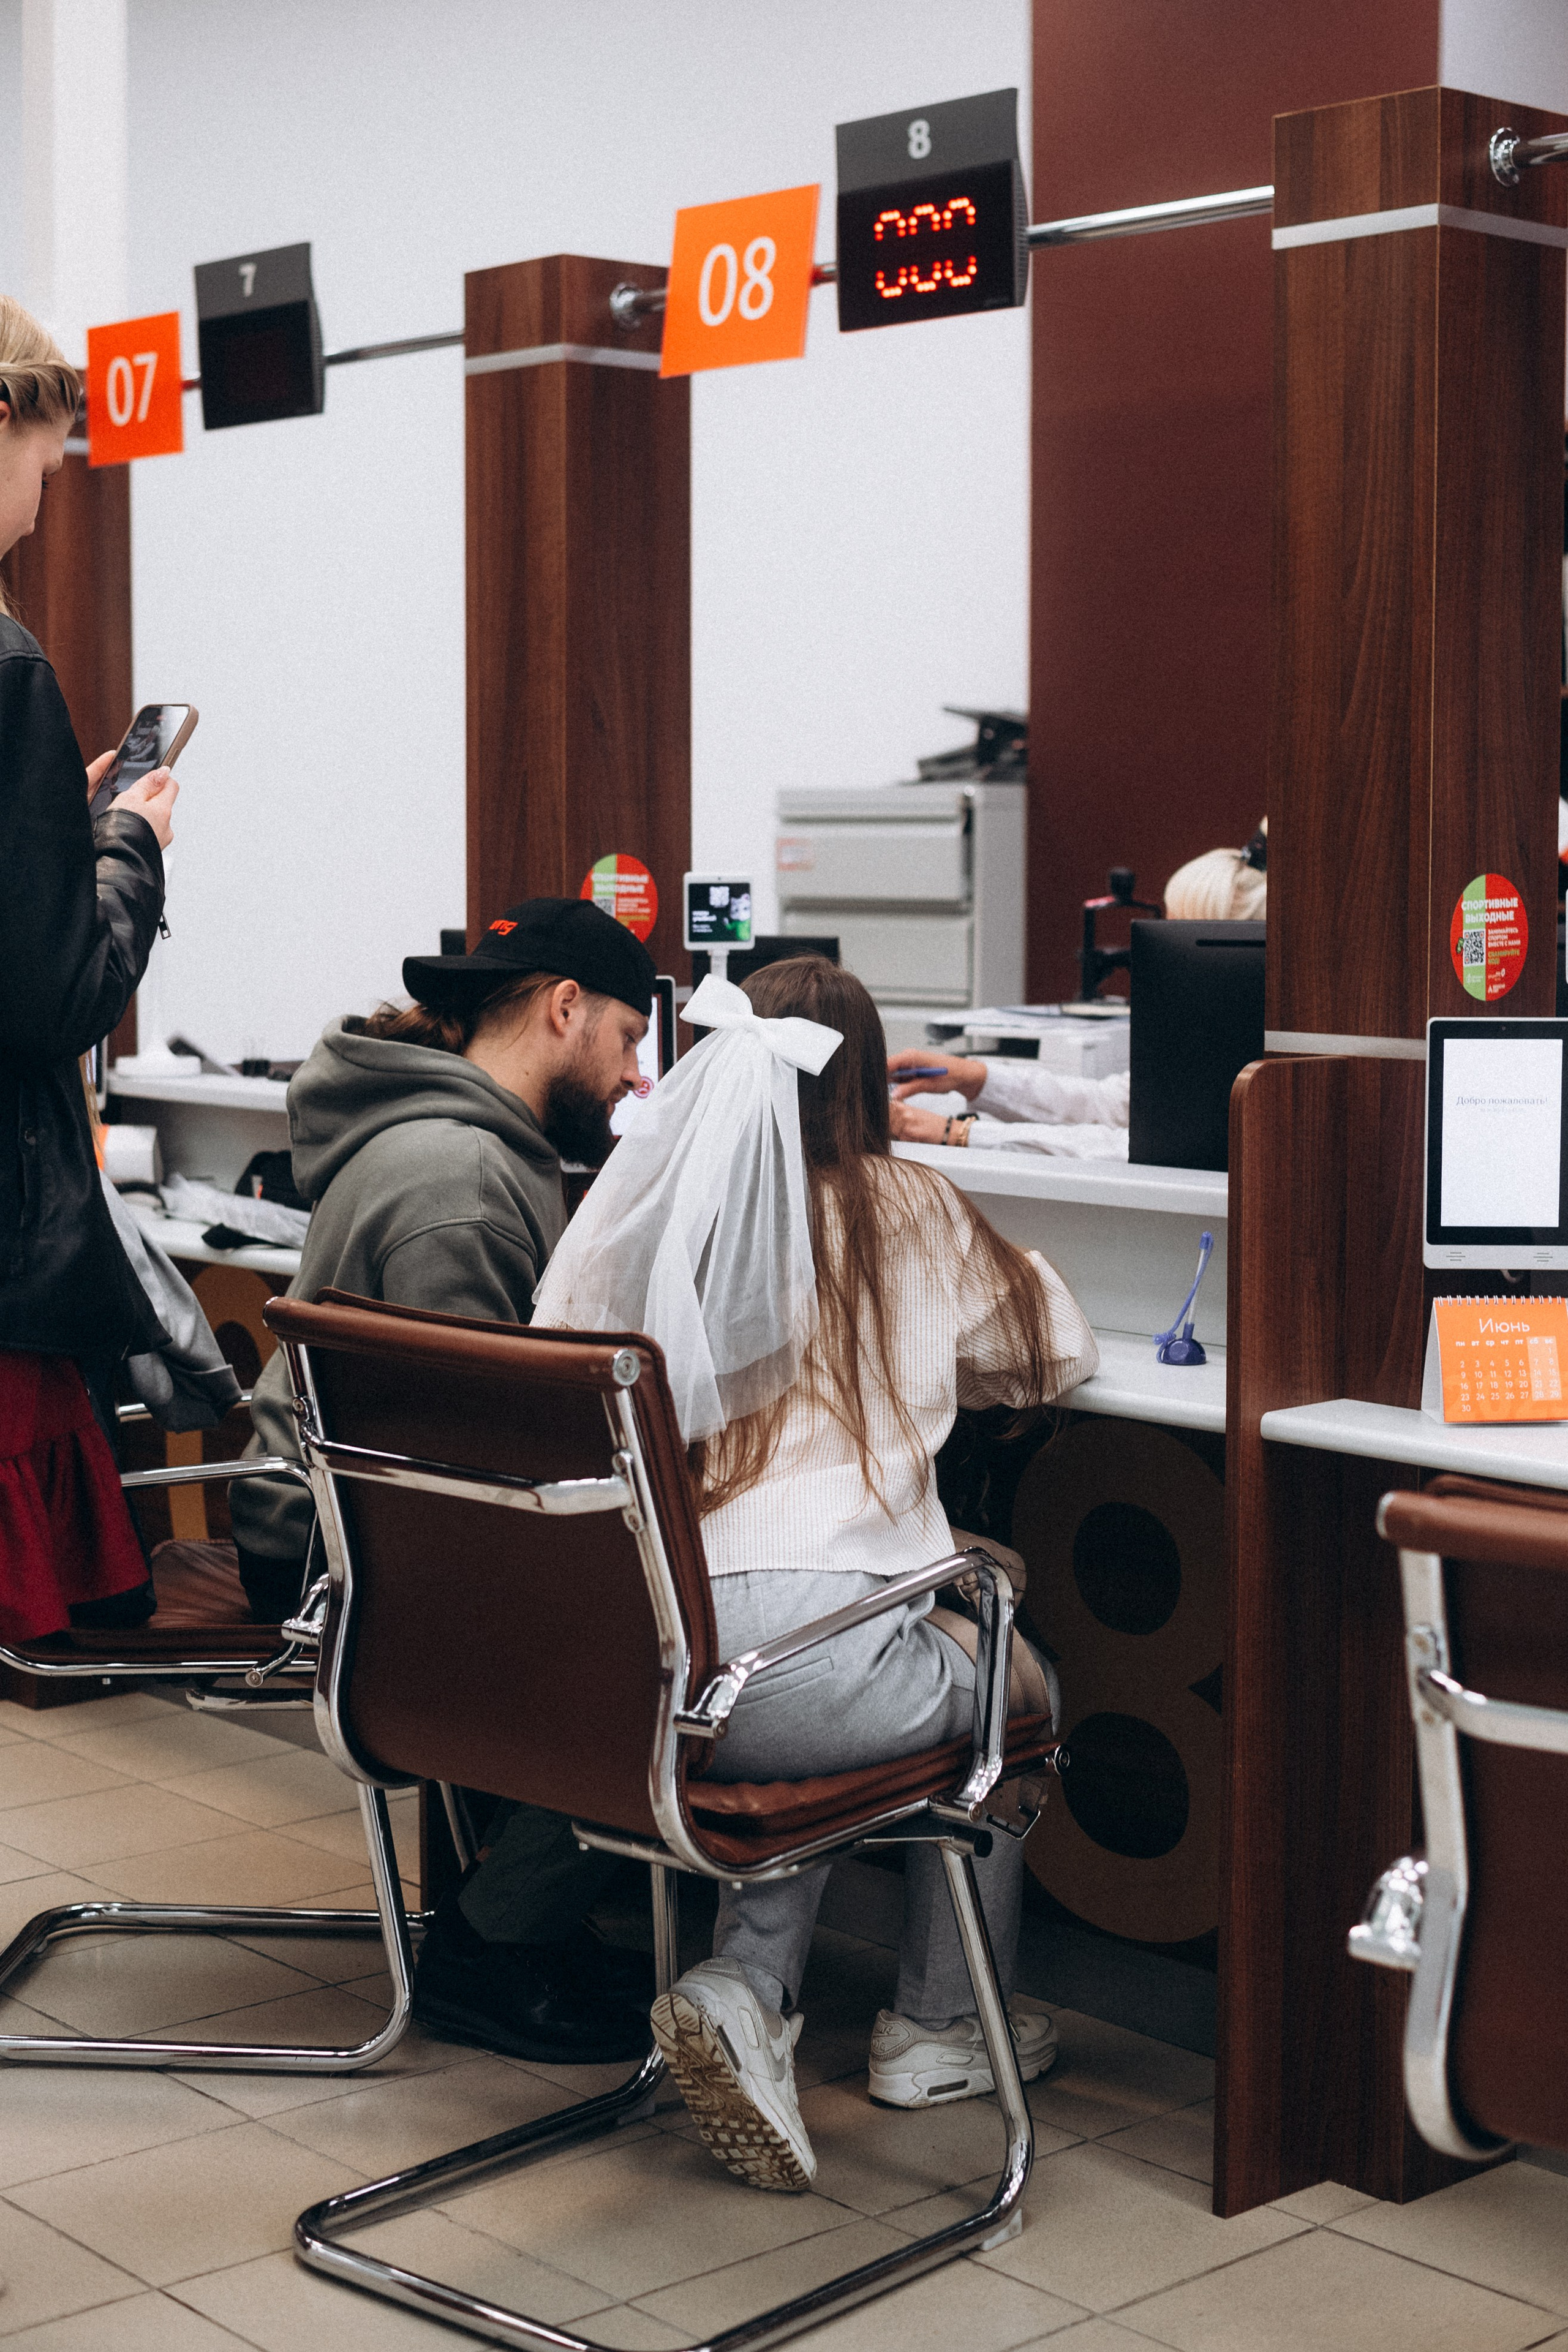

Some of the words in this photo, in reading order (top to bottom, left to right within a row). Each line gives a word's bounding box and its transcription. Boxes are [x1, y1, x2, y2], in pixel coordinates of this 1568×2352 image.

[907, 119, 932, 159] 8
[238, 262, 257, 297] 7
[698, 236, 777, 326] 08
[107, 352, 158, 427] 07
[1461, 897, 1518, 911] СПОРТИВНЫЕ
[1465, 911, 1514, 924] ВЫХОДНЫЕ
[1456, 1096, 1486, 1106] Добро
[1479, 1318, 1530, 1333] Июнь
